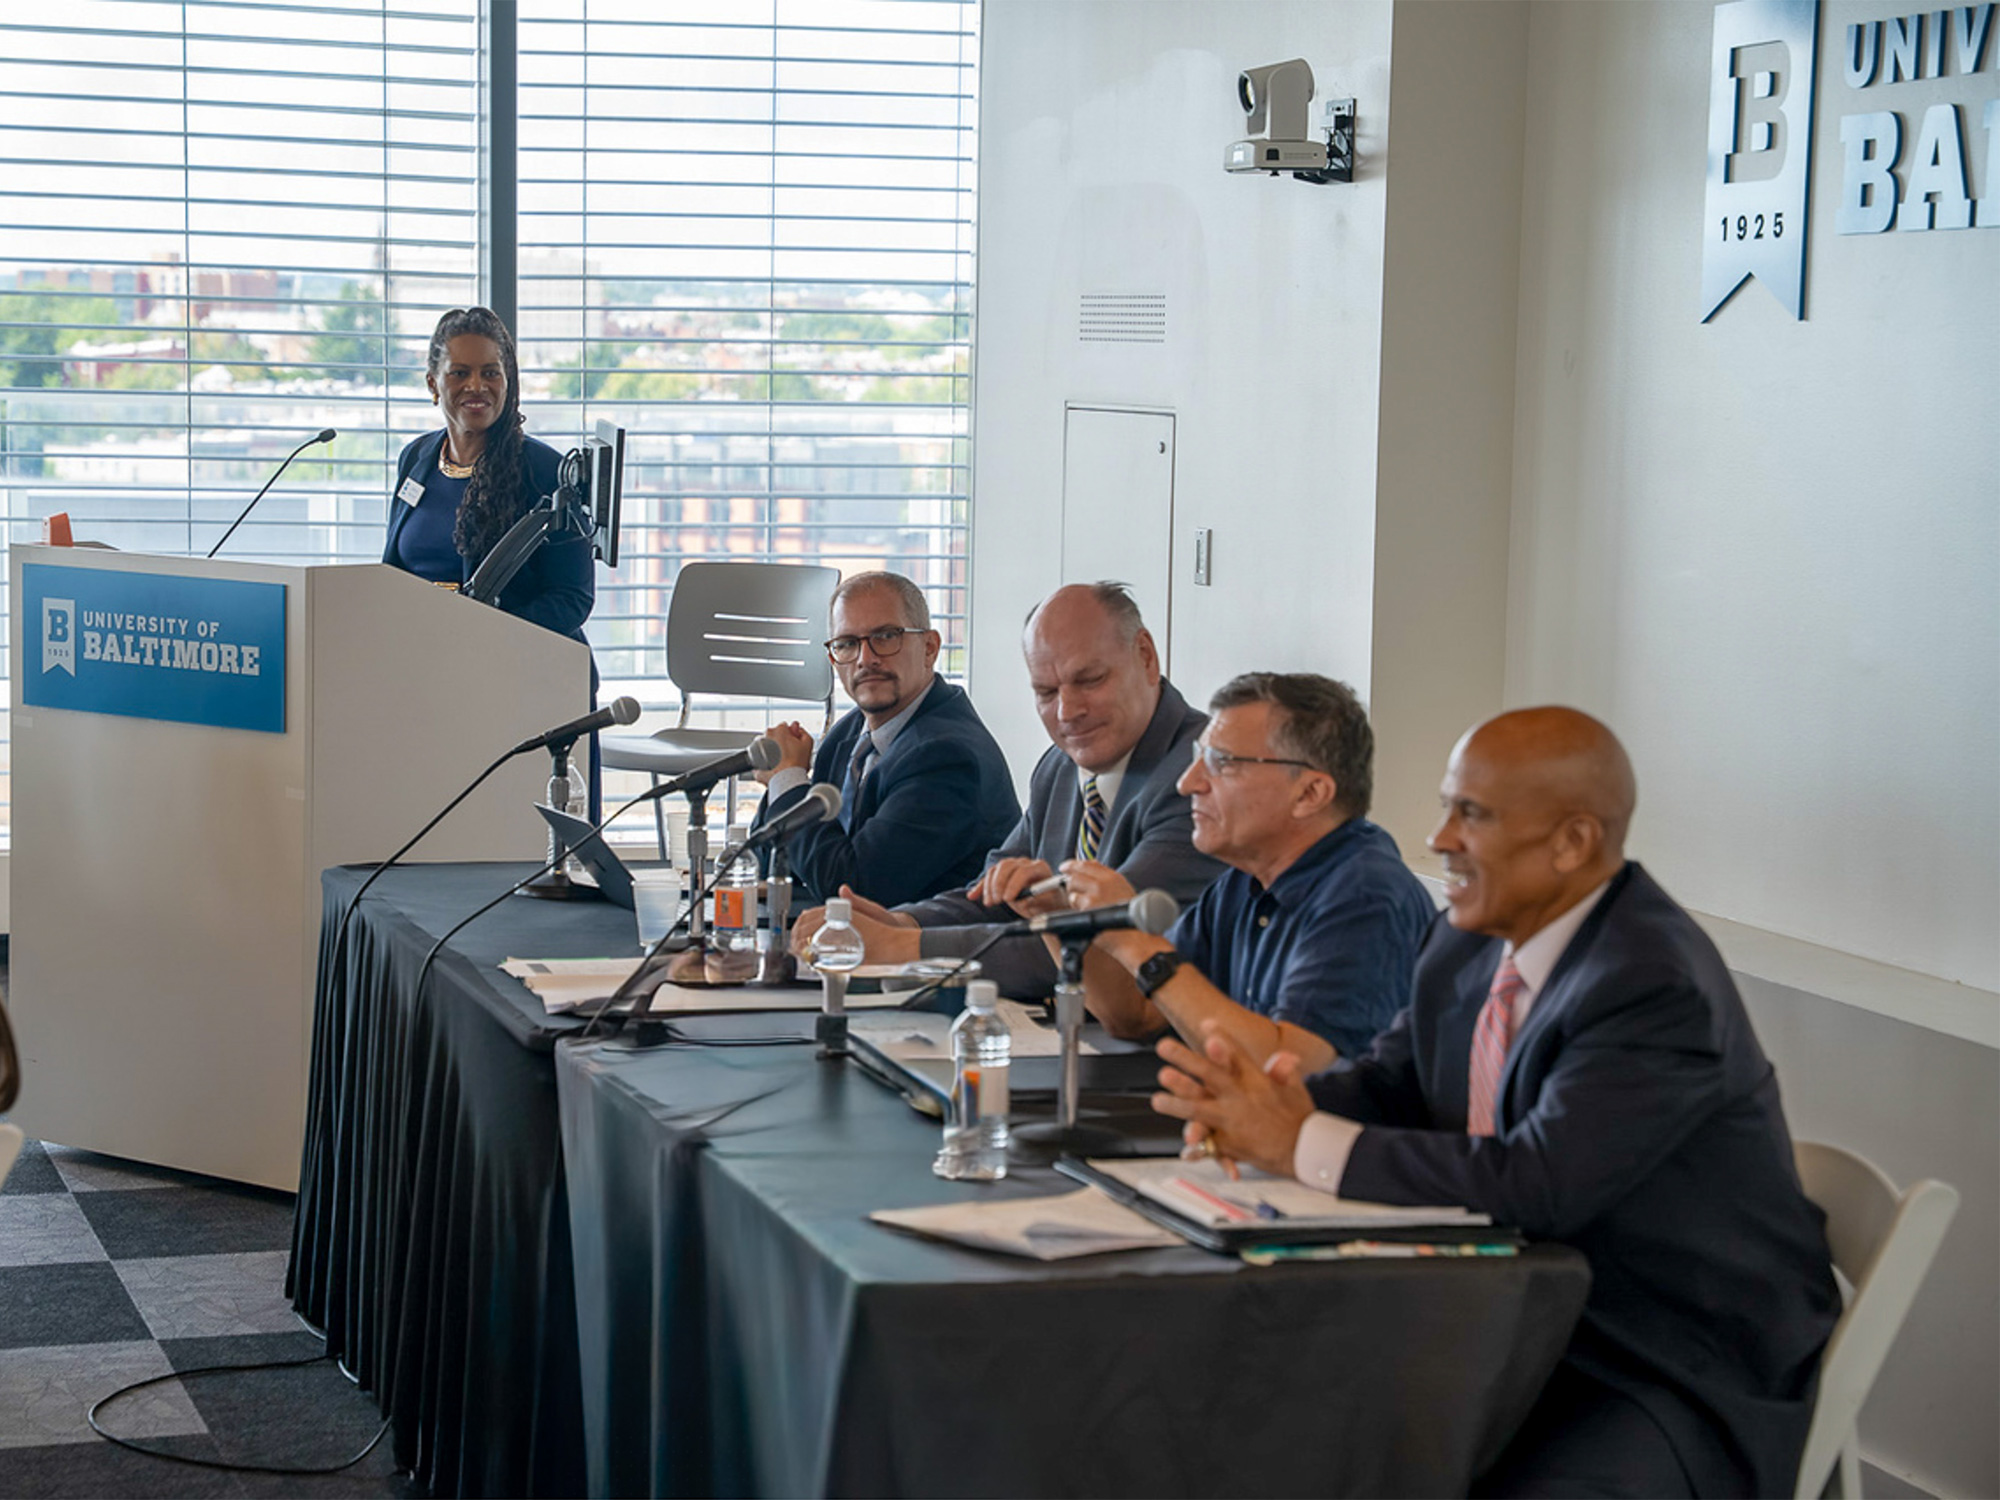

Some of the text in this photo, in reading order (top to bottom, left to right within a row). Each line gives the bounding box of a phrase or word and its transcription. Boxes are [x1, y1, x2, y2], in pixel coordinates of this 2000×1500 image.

[1844, 2, 2000, 89] UNIV
[1724, 40, 1791, 184] B
[1721, 212, 1784, 242] 1925
[48, 608, 69, 643] B
[83, 610, 220, 639] UNIVERSITY OF
[83, 630, 261, 677] BALTIMORE
